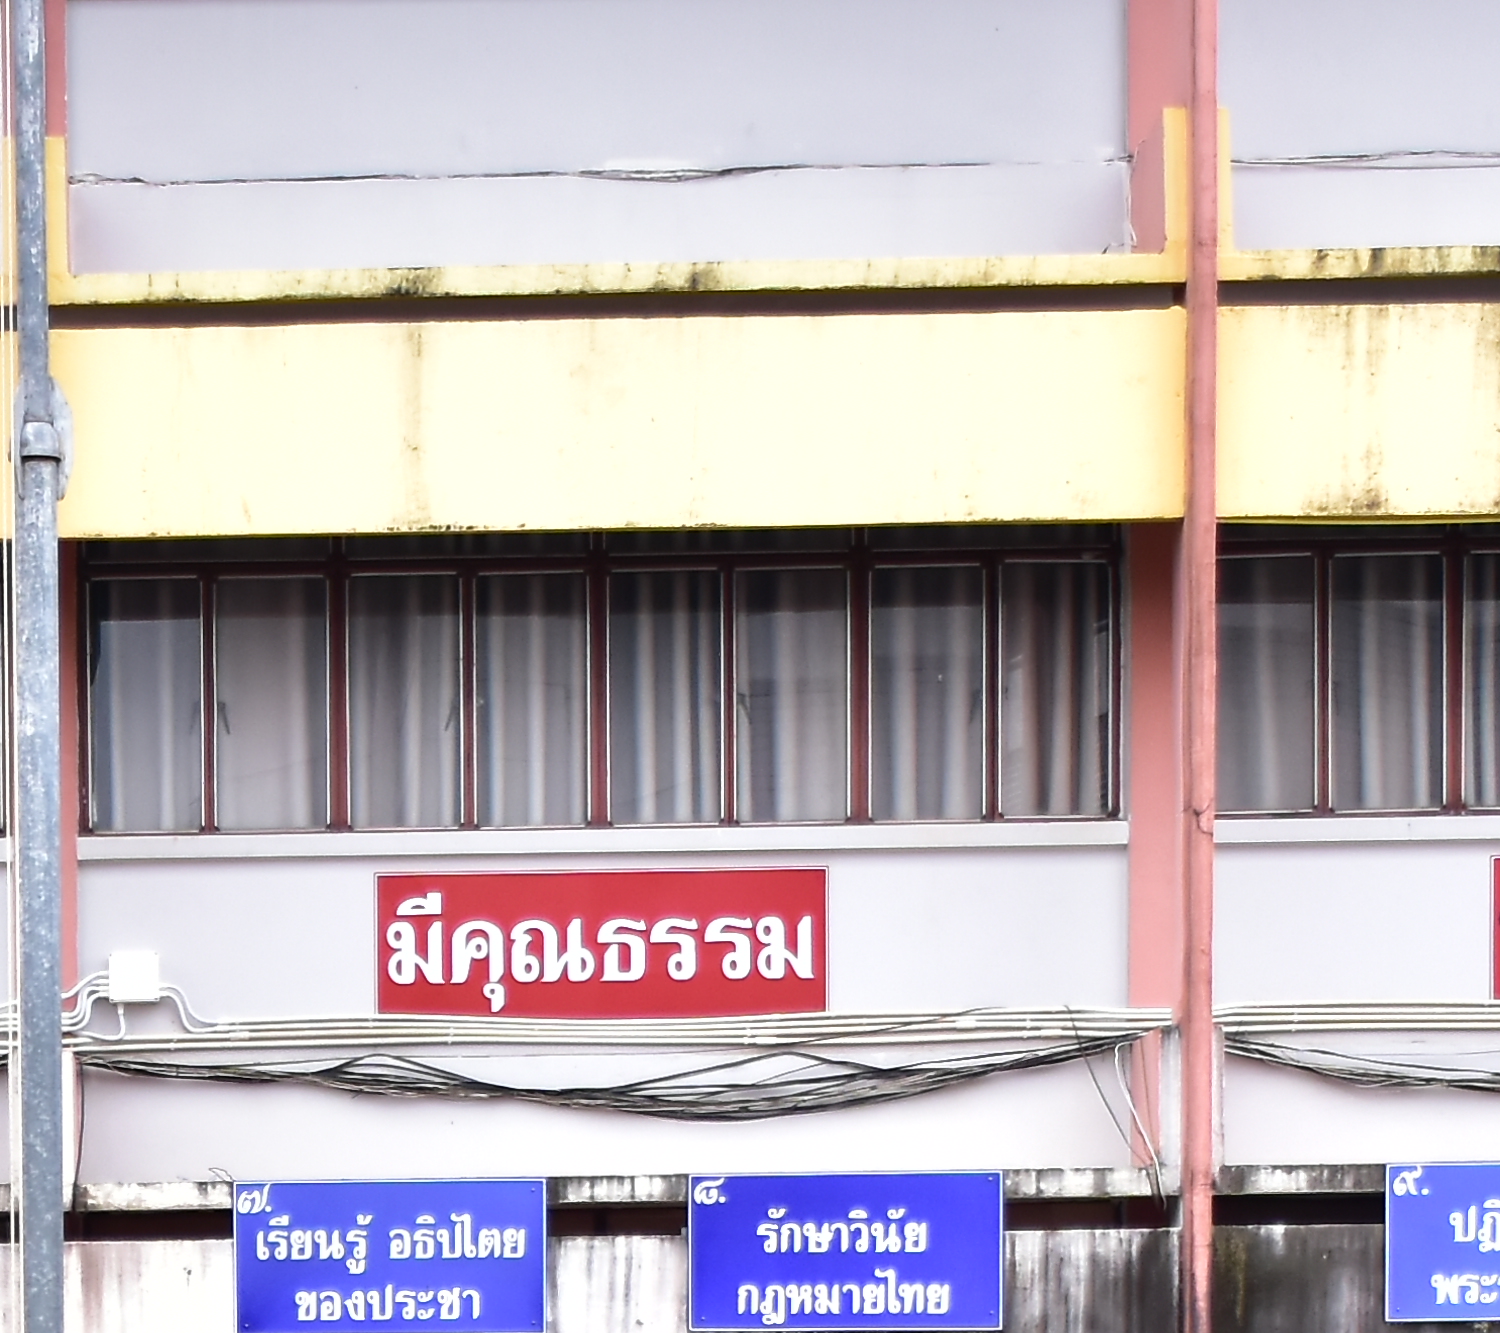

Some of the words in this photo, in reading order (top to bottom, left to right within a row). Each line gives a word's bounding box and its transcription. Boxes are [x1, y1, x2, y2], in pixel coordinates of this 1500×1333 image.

[387, 892, 814, 1012] มีคุณธรรม
[257, 1214, 373, 1274] เรียนรู้
[389, 1212, 526, 1259] อธิปไตย
[757, 1208, 927, 1253] รักษาวินัย
[295, 1284, 480, 1320] ของประชา
[738, 1268, 951, 1325] กฎหมายไทย
